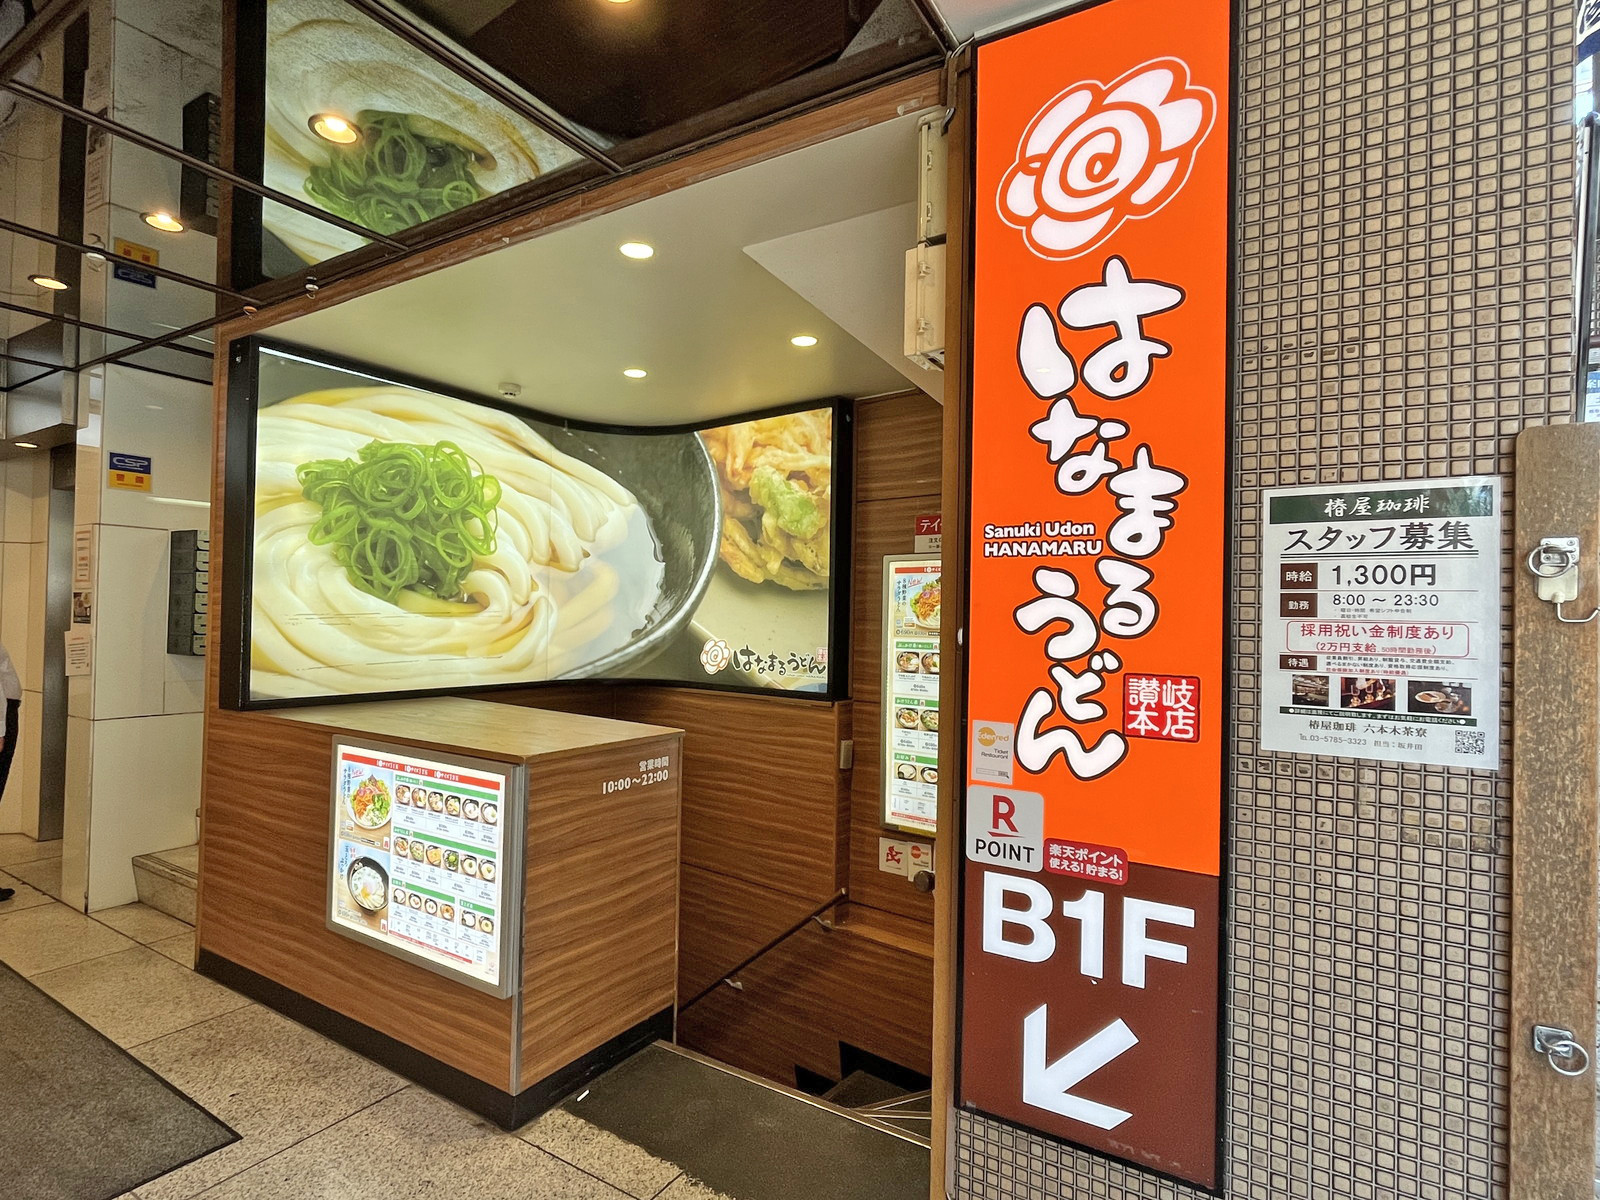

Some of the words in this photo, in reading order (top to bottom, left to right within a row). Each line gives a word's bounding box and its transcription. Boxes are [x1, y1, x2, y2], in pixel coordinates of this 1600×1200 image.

[112, 456, 149, 468] CSP
[1324, 494, 1430, 517] 椿屋珈琲
[920, 518, 942, 533] テイ
[1015, 255, 1187, 780] はなまるうどん
[984, 523, 1041, 540] Sanuki
[1045, 520, 1096, 538] Udon
[1284, 521, 1474, 551] スタッフ募集
[984, 540, 1103, 557] HANAMARU
[1285, 570, 1313, 584] 時給
[1332, 563, 1437, 587] 1,300円
[1288, 600, 1310, 611] 勤務
[1333, 594, 1365, 606] 8:00
[1394, 594, 1439, 606] 23:30
[1301, 623, 1454, 640] 採用祝い金制度あり
[733, 644, 827, 675] はなまるうどん
[1288, 658, 1309, 667] 待遇
[1126, 711, 1196, 740] 本店
[1309, 719, 1358, 733] 椿屋珈琲
[1363, 723, 1428, 738] 六本木茶寮
[639, 756, 669, 772] 営業時間
[992, 795, 1019, 833] R
[975, 838, 1035, 864] POINT
[1049, 842, 1124, 867] 楽天ポイント
[983, 870, 1194, 989] B1F
